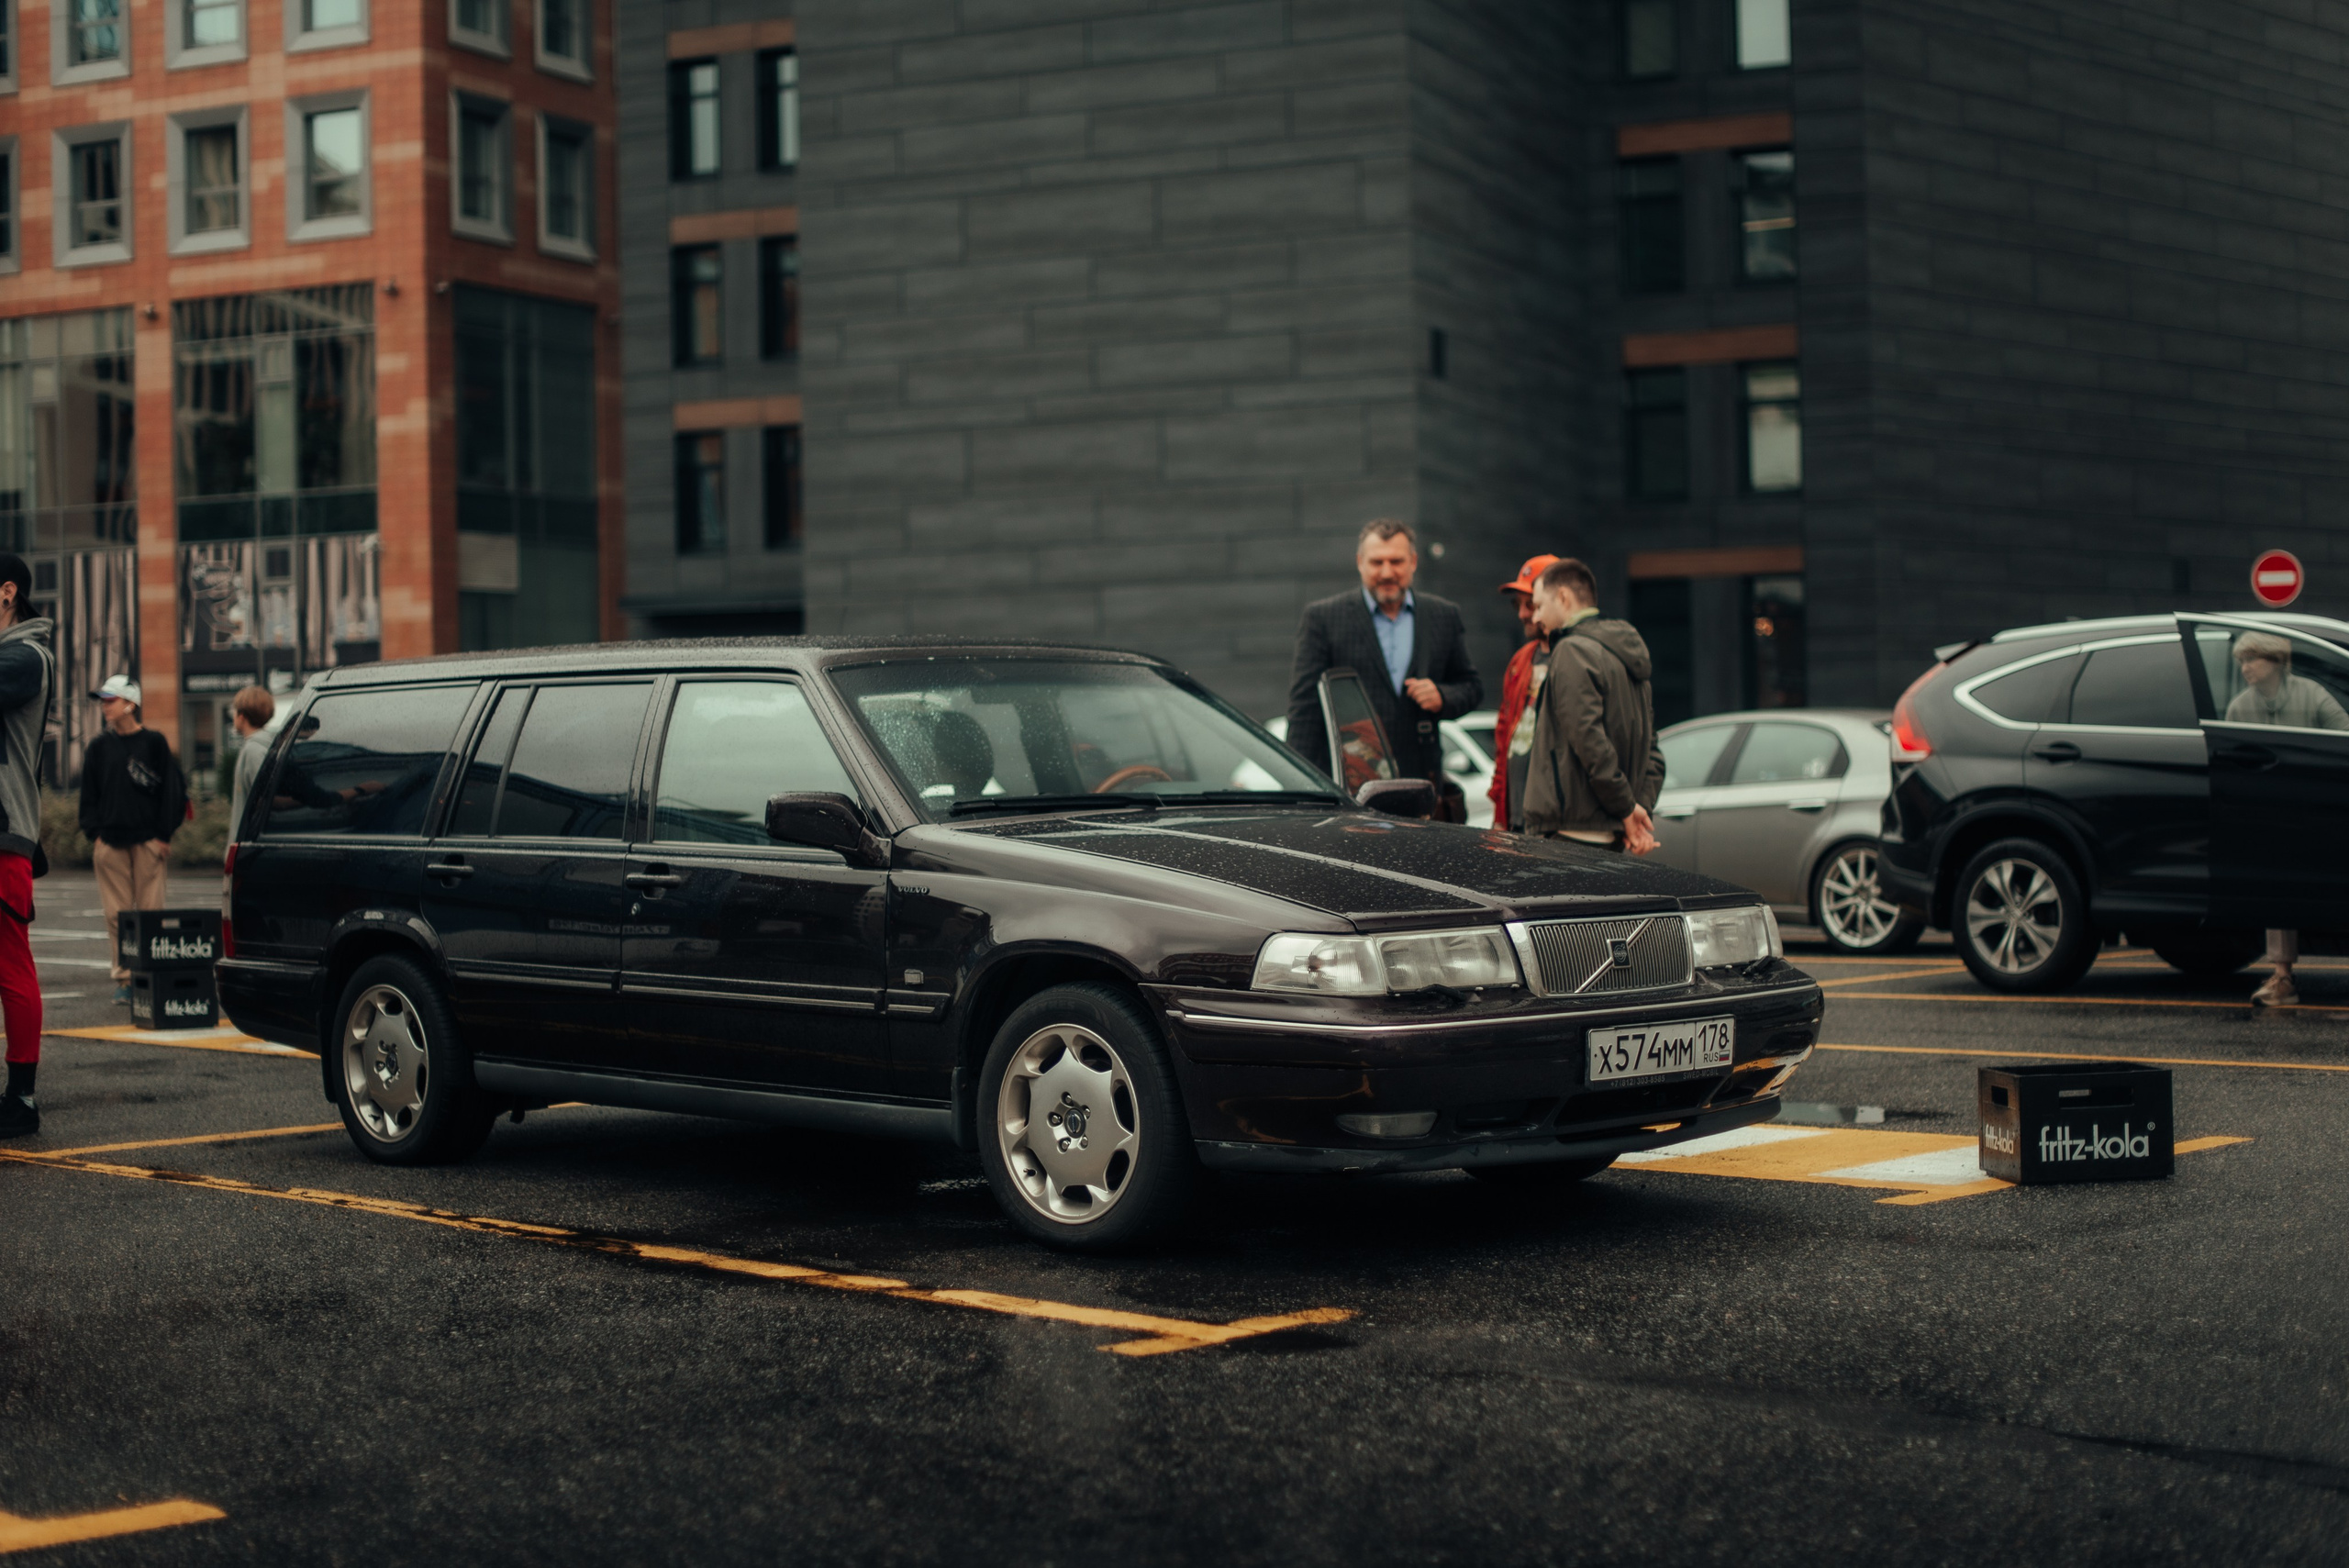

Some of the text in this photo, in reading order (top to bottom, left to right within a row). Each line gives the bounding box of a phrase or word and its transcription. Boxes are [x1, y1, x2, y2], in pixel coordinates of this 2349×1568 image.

[897, 885, 929, 895] VOLVO
[150, 936, 213, 960] fritz-kola
[1698, 1022, 1728, 1052] 178
[1703, 1051, 1719, 1063] RUS
[1683, 1068, 1719, 1080] SWED-MOBIL
[2039, 1122, 2150, 1162] fritz-kola
